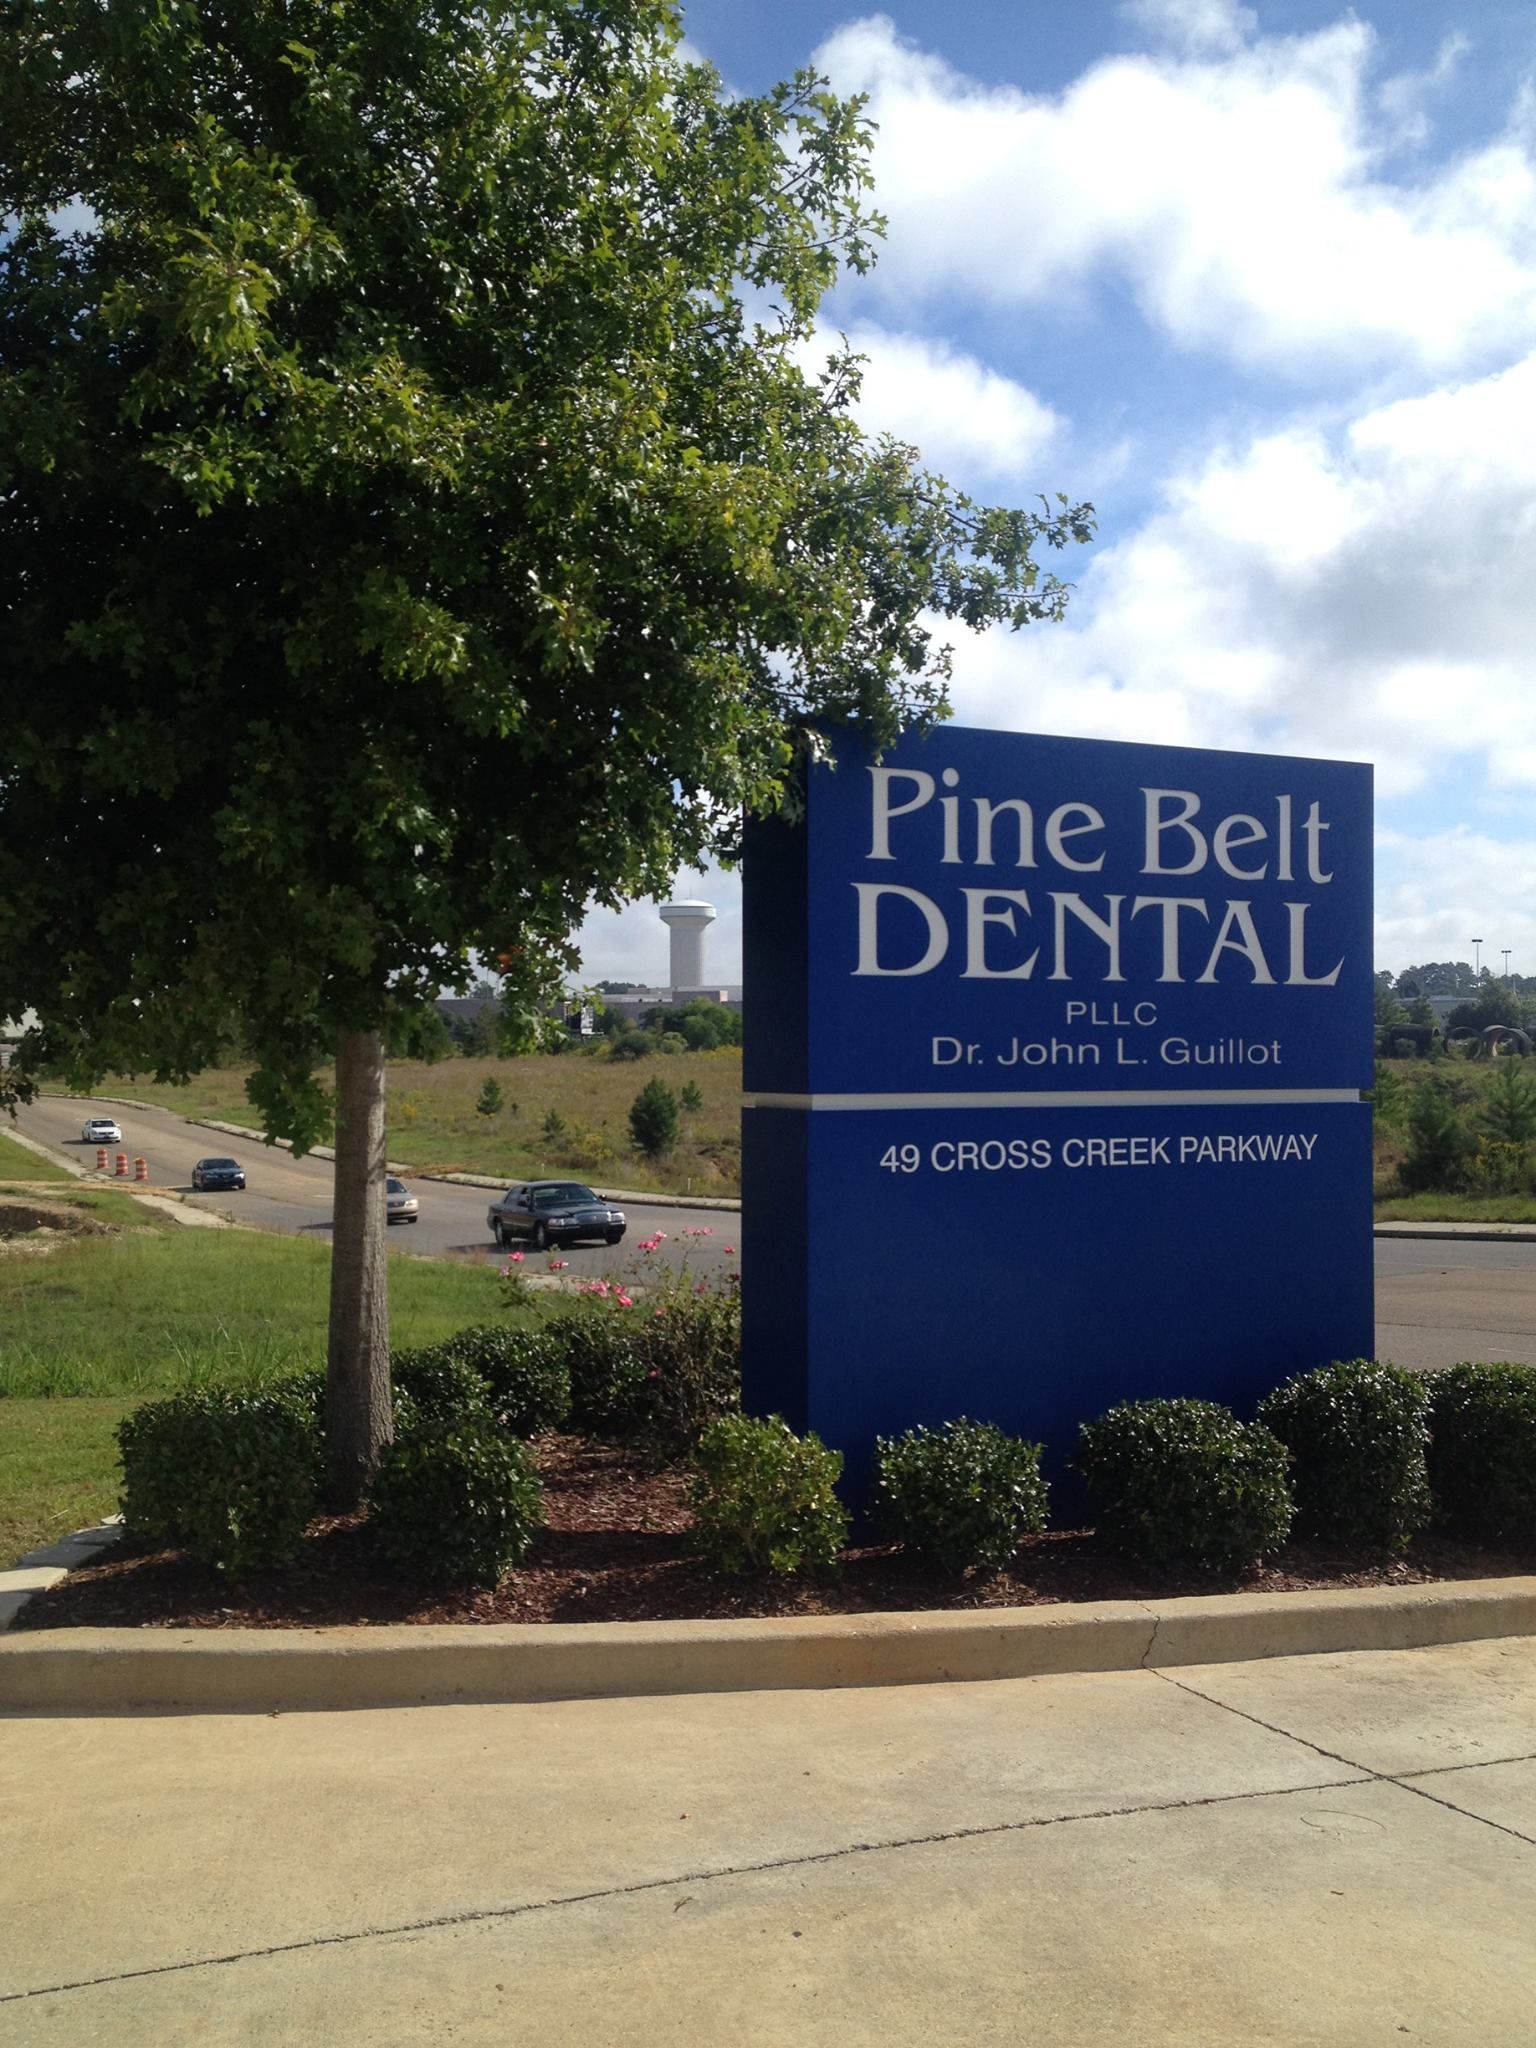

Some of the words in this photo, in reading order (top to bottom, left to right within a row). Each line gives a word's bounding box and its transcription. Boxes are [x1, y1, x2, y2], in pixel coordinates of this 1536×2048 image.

[865, 766, 1105, 872] Pine
[1137, 787, 1333, 884] Belt
[850, 882, 1345, 986] DENTAL
[1066, 1001, 1157, 1026] PLLC
[932, 1036, 983, 1065] Dr.
[997, 1037, 1100, 1065] John
[1117, 1037, 1149, 1065] L.
[1160, 1037, 1282, 1065] Guillot
[879, 1145, 921, 1173] 49
[931, 1139, 1052, 1172] CROSS
[1062, 1137, 1171, 1168] CREEK
[1180, 1133, 1319, 1164] PARKWAY
